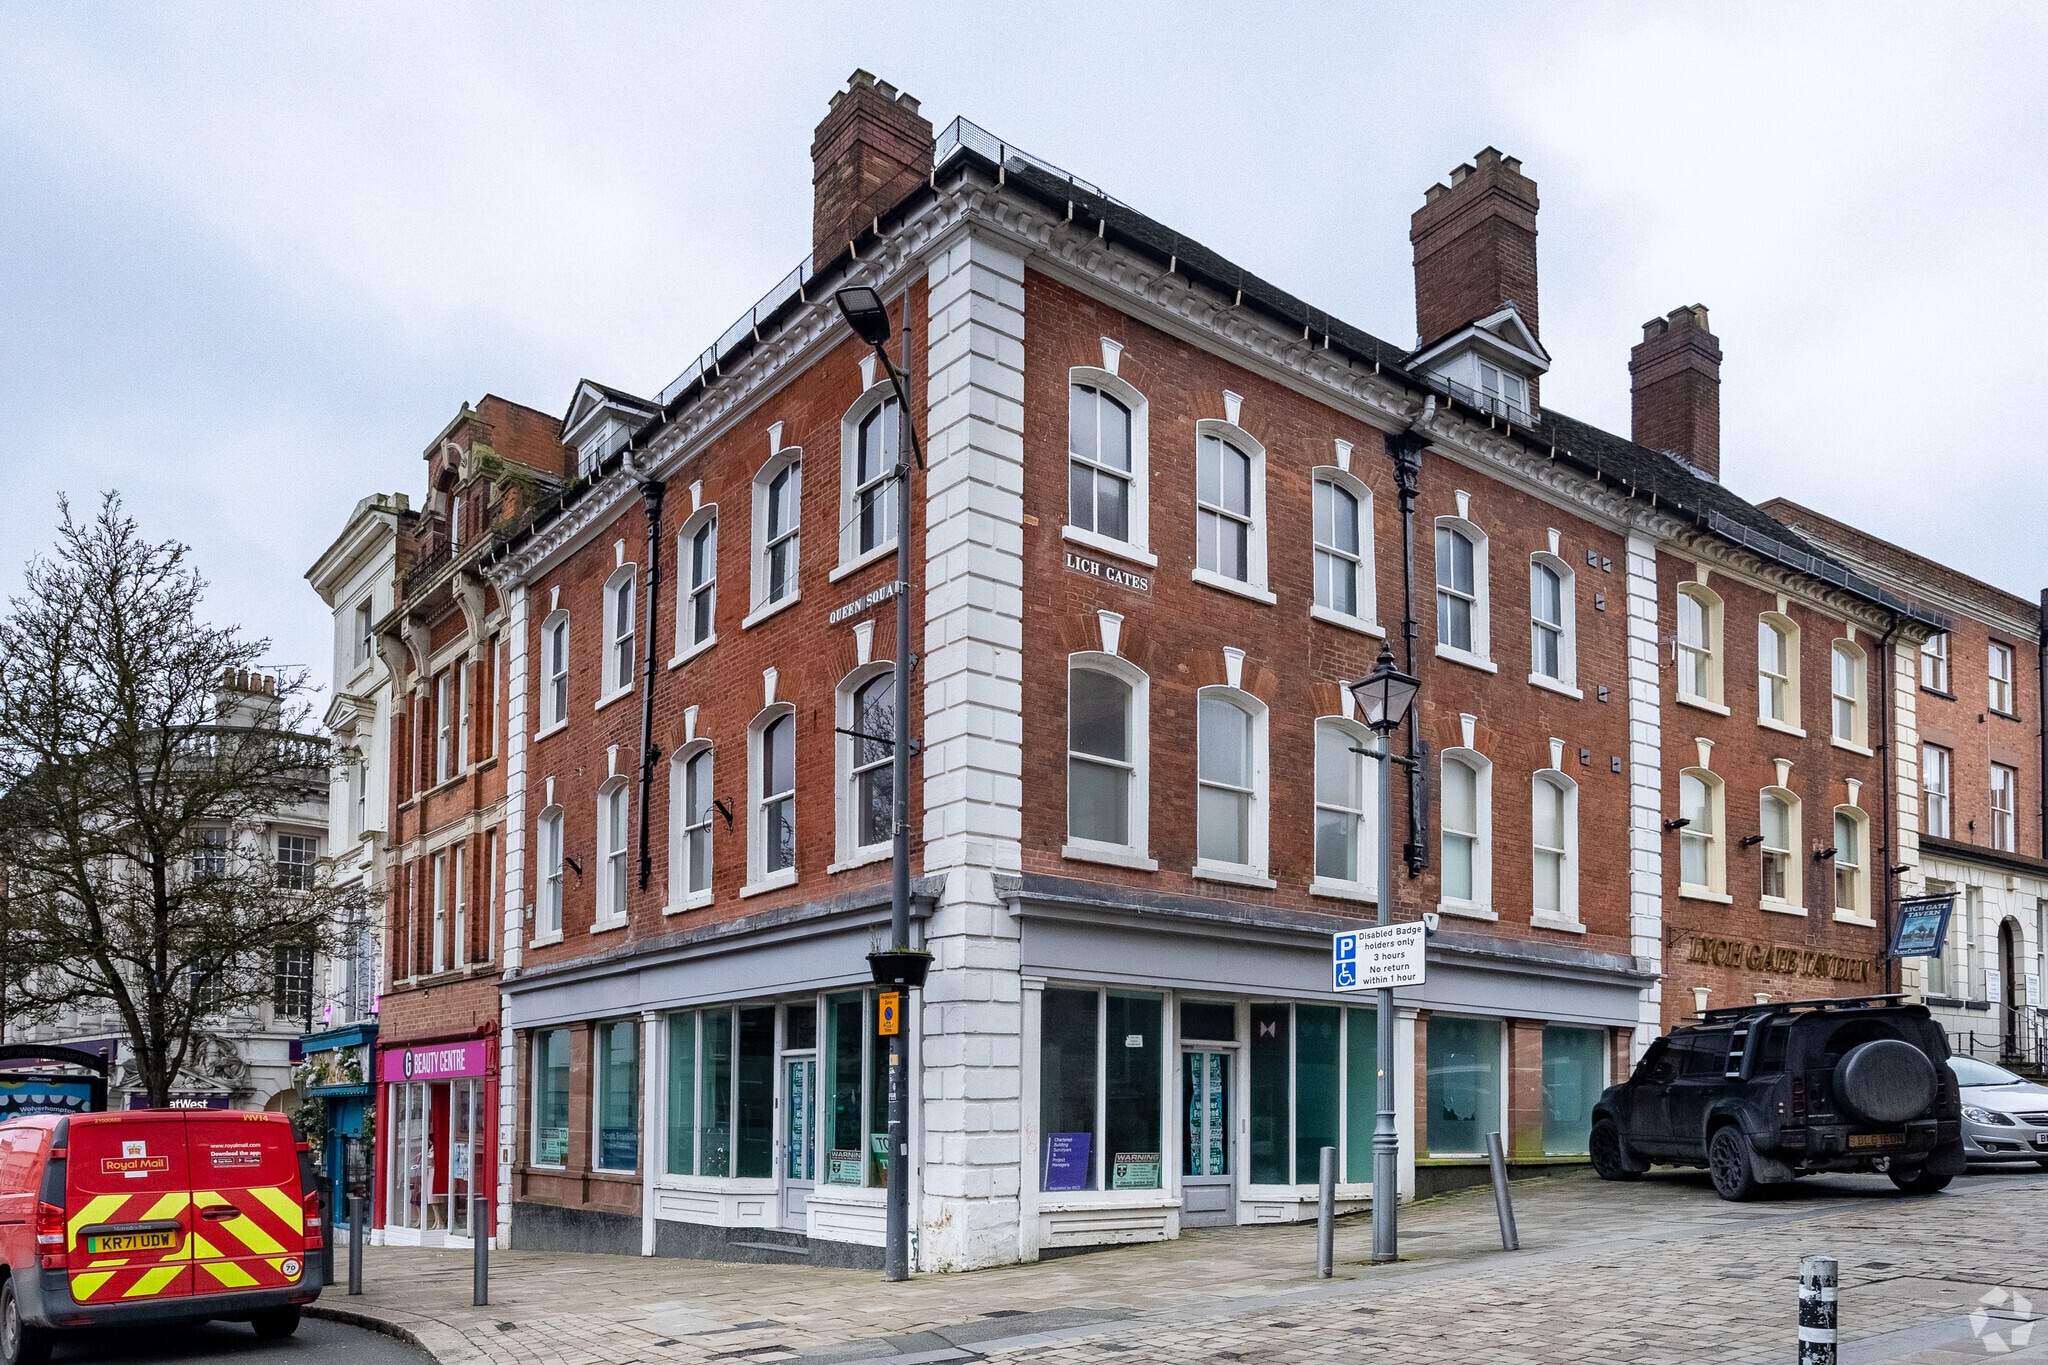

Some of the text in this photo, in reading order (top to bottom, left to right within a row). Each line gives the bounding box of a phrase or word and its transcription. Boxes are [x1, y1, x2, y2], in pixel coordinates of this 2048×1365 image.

[1066, 553, 1148, 591] LICH GATES
[829, 581, 899, 624] QUEEN SQUA
[1908, 910, 1941, 918] TAVERN
[1359, 926, 1422, 940] Disabled Badge
[1341, 938, 1354, 958] P
[1364, 937, 1415, 950] holders only
[1374, 951, 1405, 961] 3 hours
[1688, 935, 1871, 982] LYCH GATE TAVERN
[1384, 963, 1410, 972] return
[1363, 976, 1388, 985] within
[1397, 974, 1416, 982] hour
[414, 1051, 439, 1074] BEAUTY
[440, 1048, 466, 1072] CENTRE
[19, 1105, 77, 1114] Wolverhampton
[170, 1099, 209, 1109] atWest
[243, 1113, 269, 1122] WV14
[832, 1151, 861, 1159] WARNIN
[106, 1159, 164, 1170] Royal Mail
[102, 1234, 169, 1250] KR71 UDW
